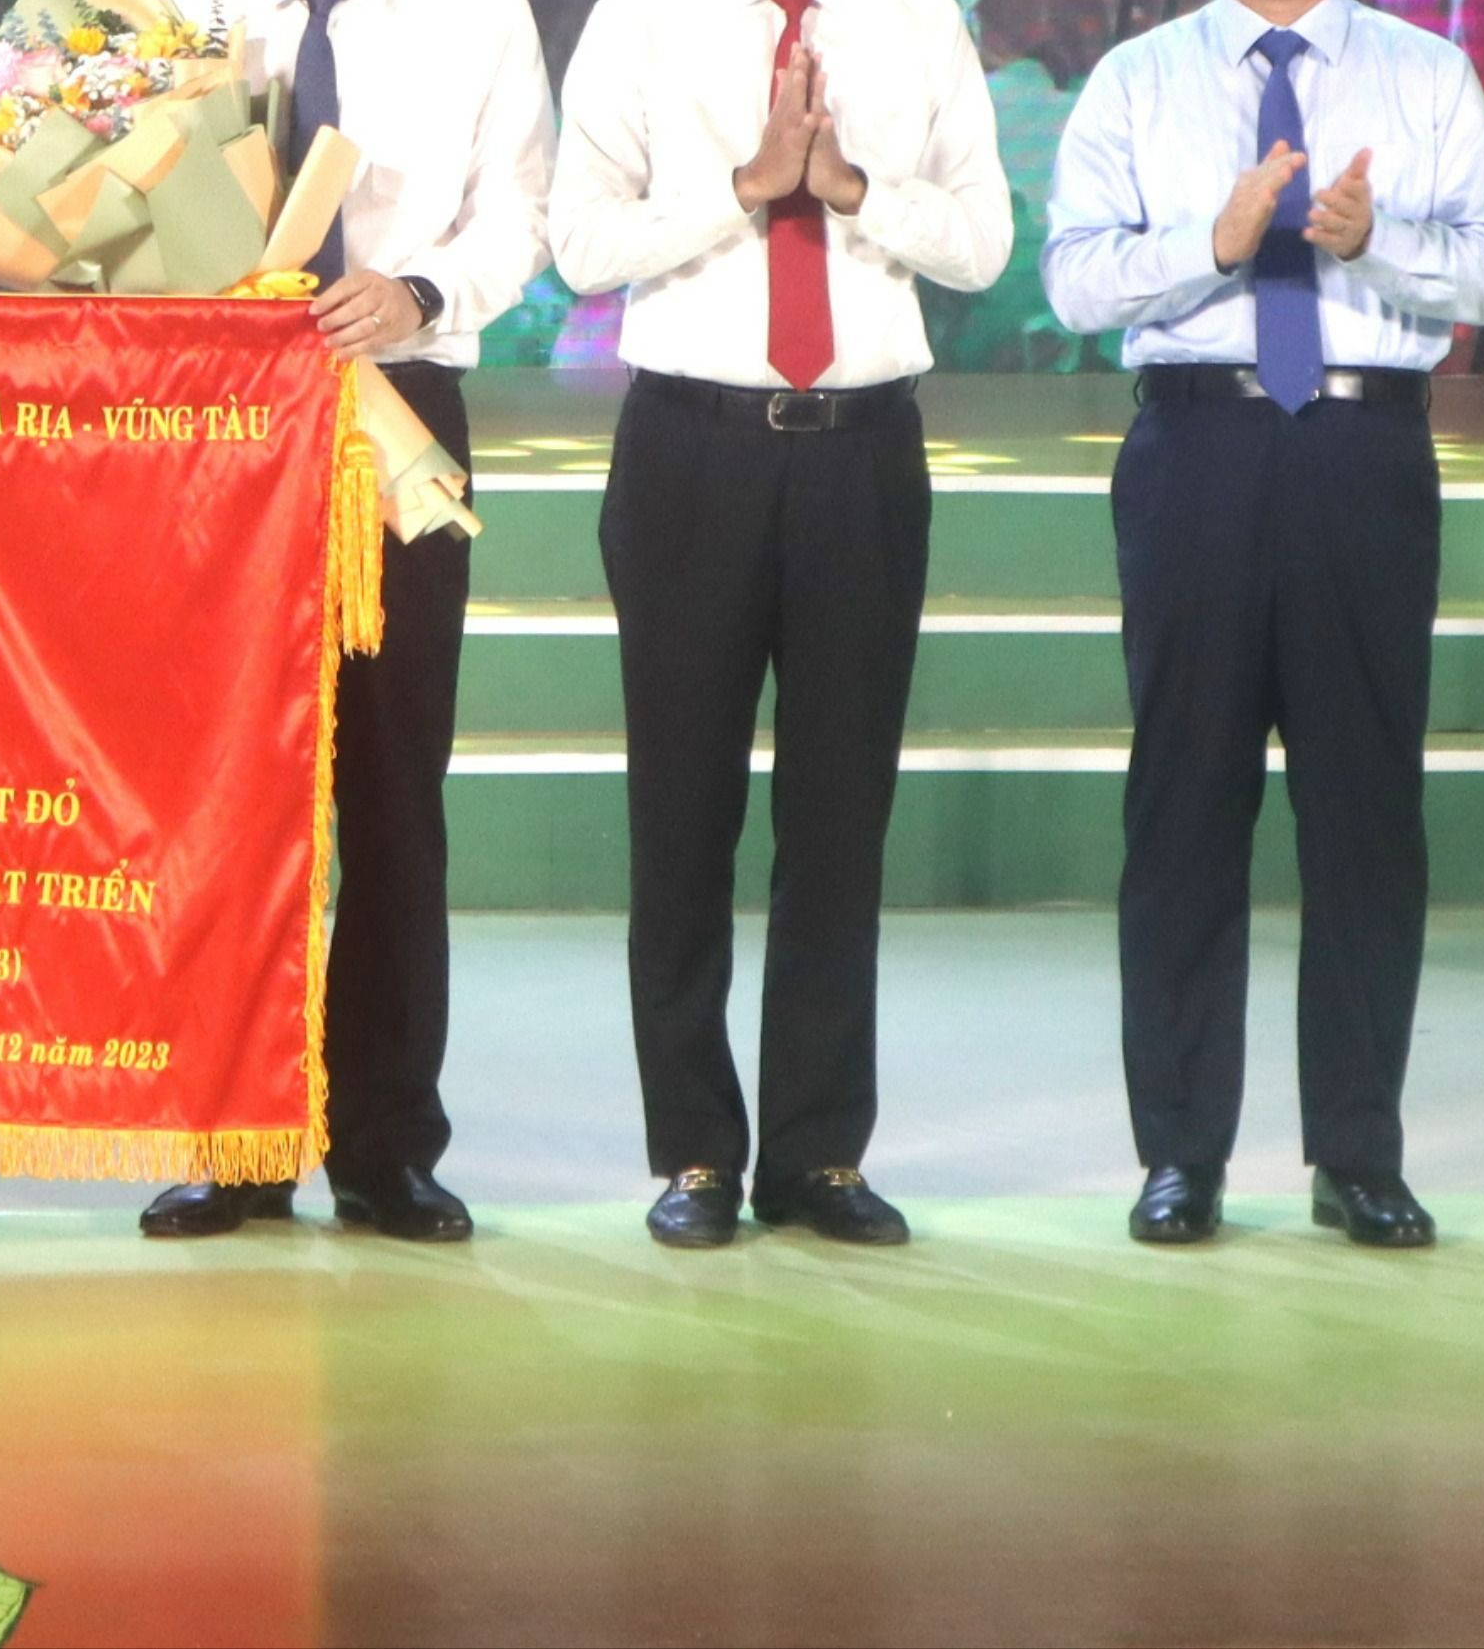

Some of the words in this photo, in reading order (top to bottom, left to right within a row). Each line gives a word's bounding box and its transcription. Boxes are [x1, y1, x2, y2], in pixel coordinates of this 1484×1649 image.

[15, 402, 73, 446] RỊA
[102, 398, 194, 441] VŨNG
[202, 393, 271, 440] TÀU
[25, 778, 80, 826] ĐỎ
[36, 859, 156, 914] TRIỂN
[30, 1036, 94, 1067] năm
[102, 1038, 171, 1070] 2023
